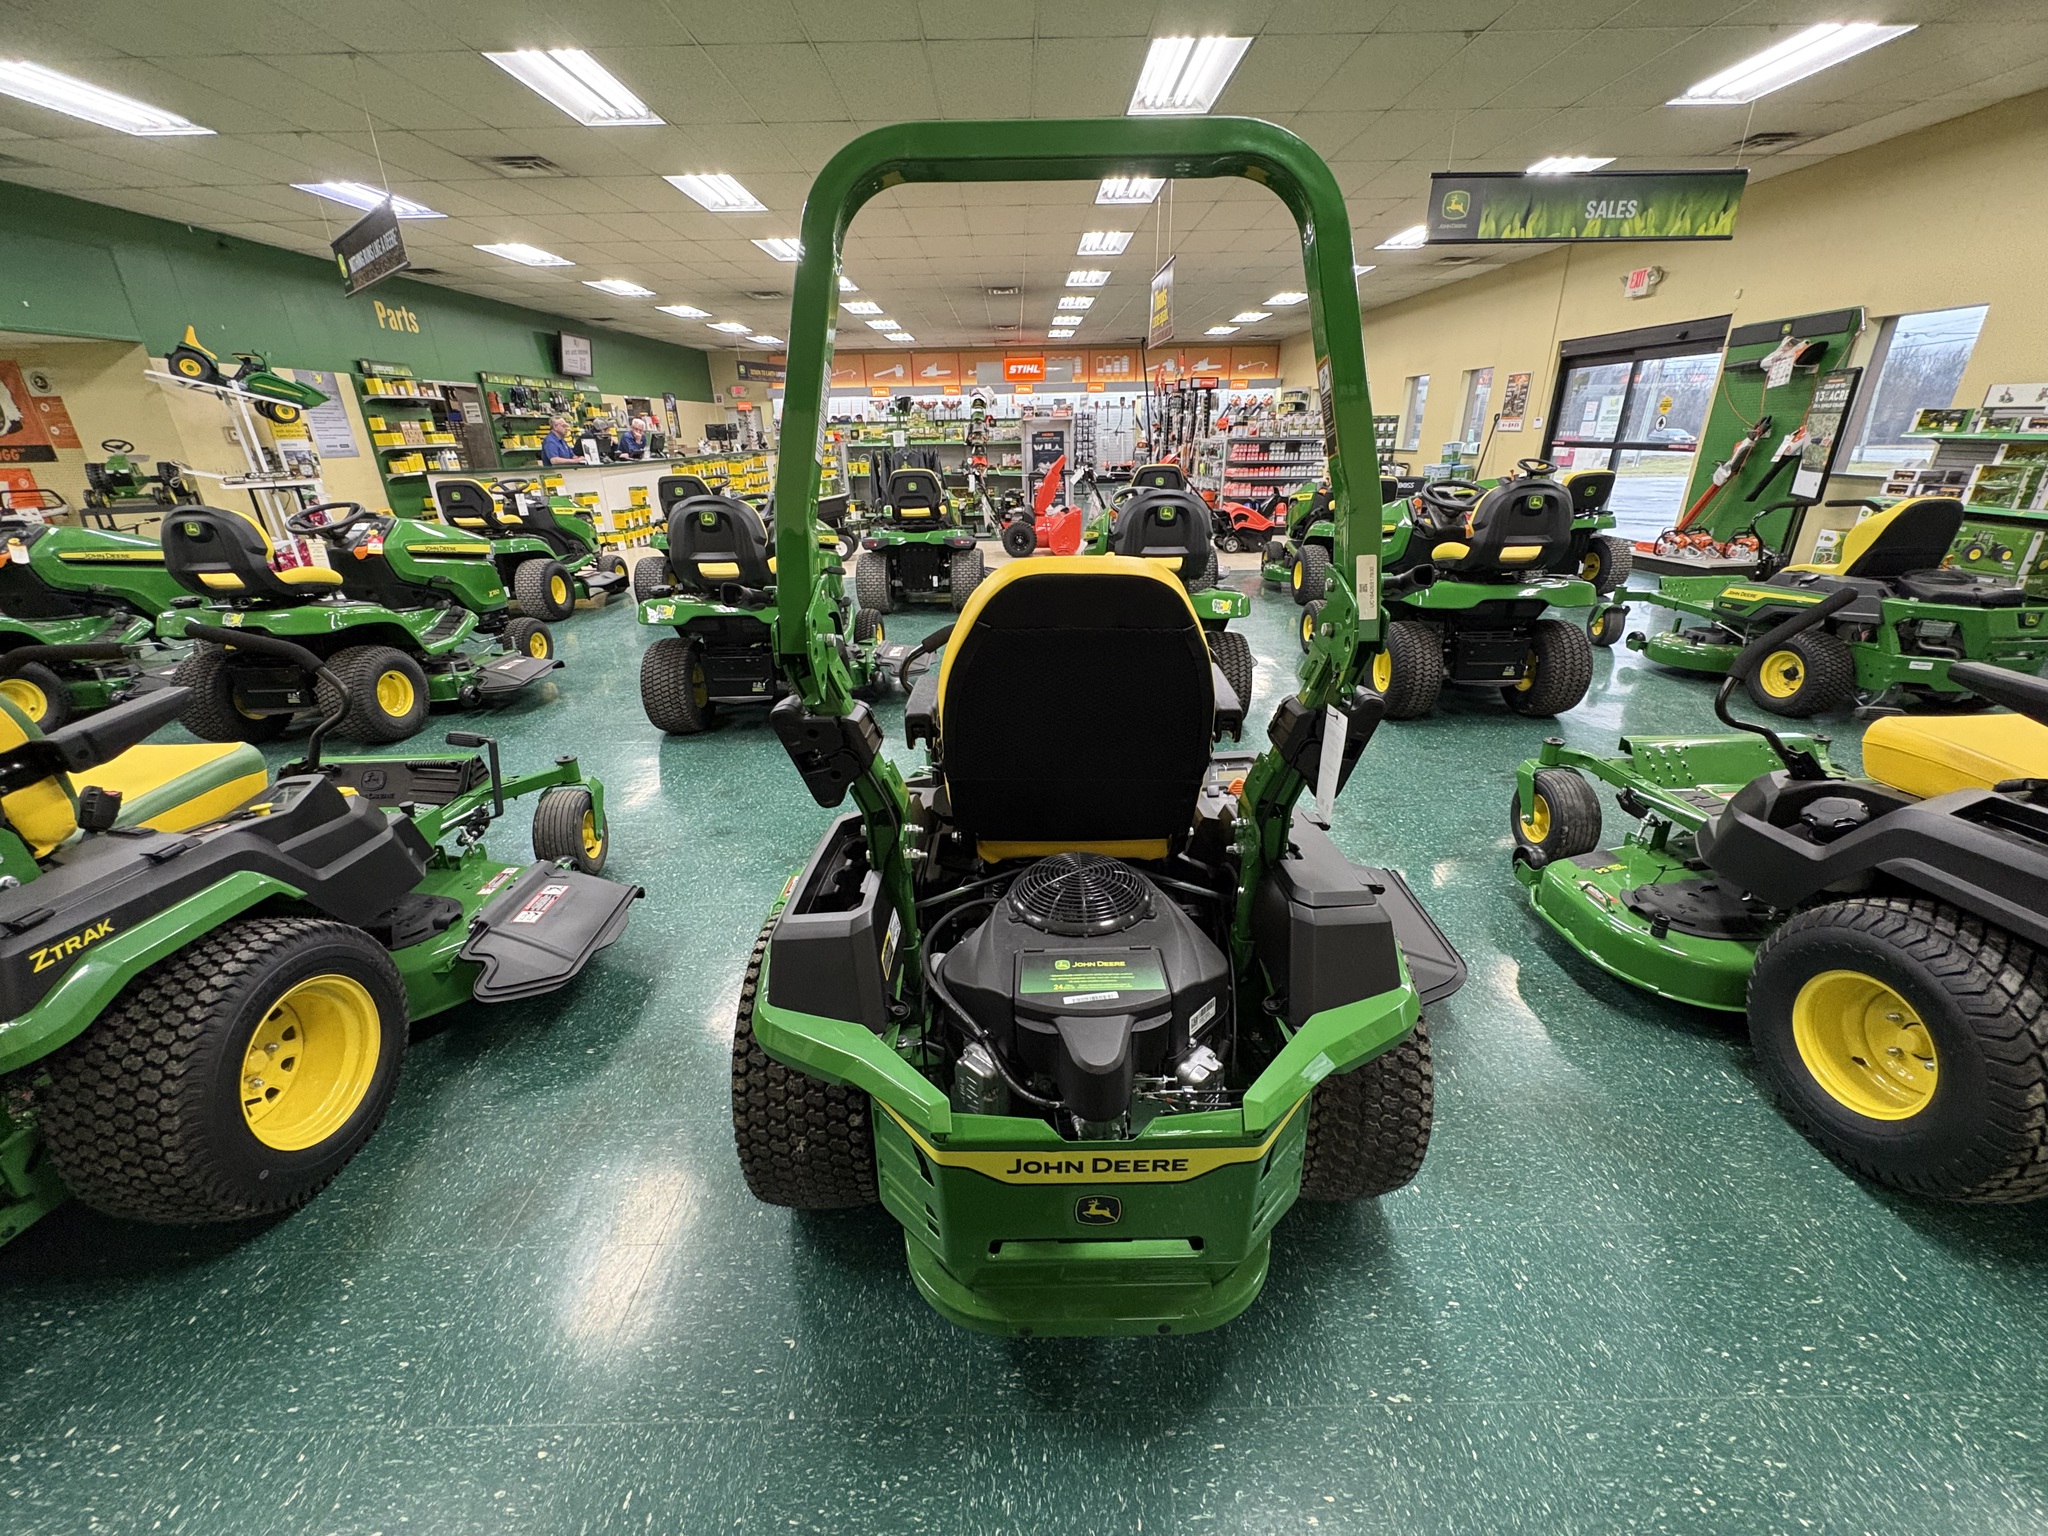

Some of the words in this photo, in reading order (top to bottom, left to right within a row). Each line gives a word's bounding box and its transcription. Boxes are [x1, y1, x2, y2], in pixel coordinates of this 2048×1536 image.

[1584, 199, 1638, 219] SALES
[1629, 269, 1648, 288] EXIT
[374, 300, 420, 333] Parts
[1009, 364, 1041, 374] STIHL
[28, 917, 115, 974] ZTRAK
[1006, 1158, 1084, 1175] JOHN
[1091, 1157, 1189, 1173] DEERE
